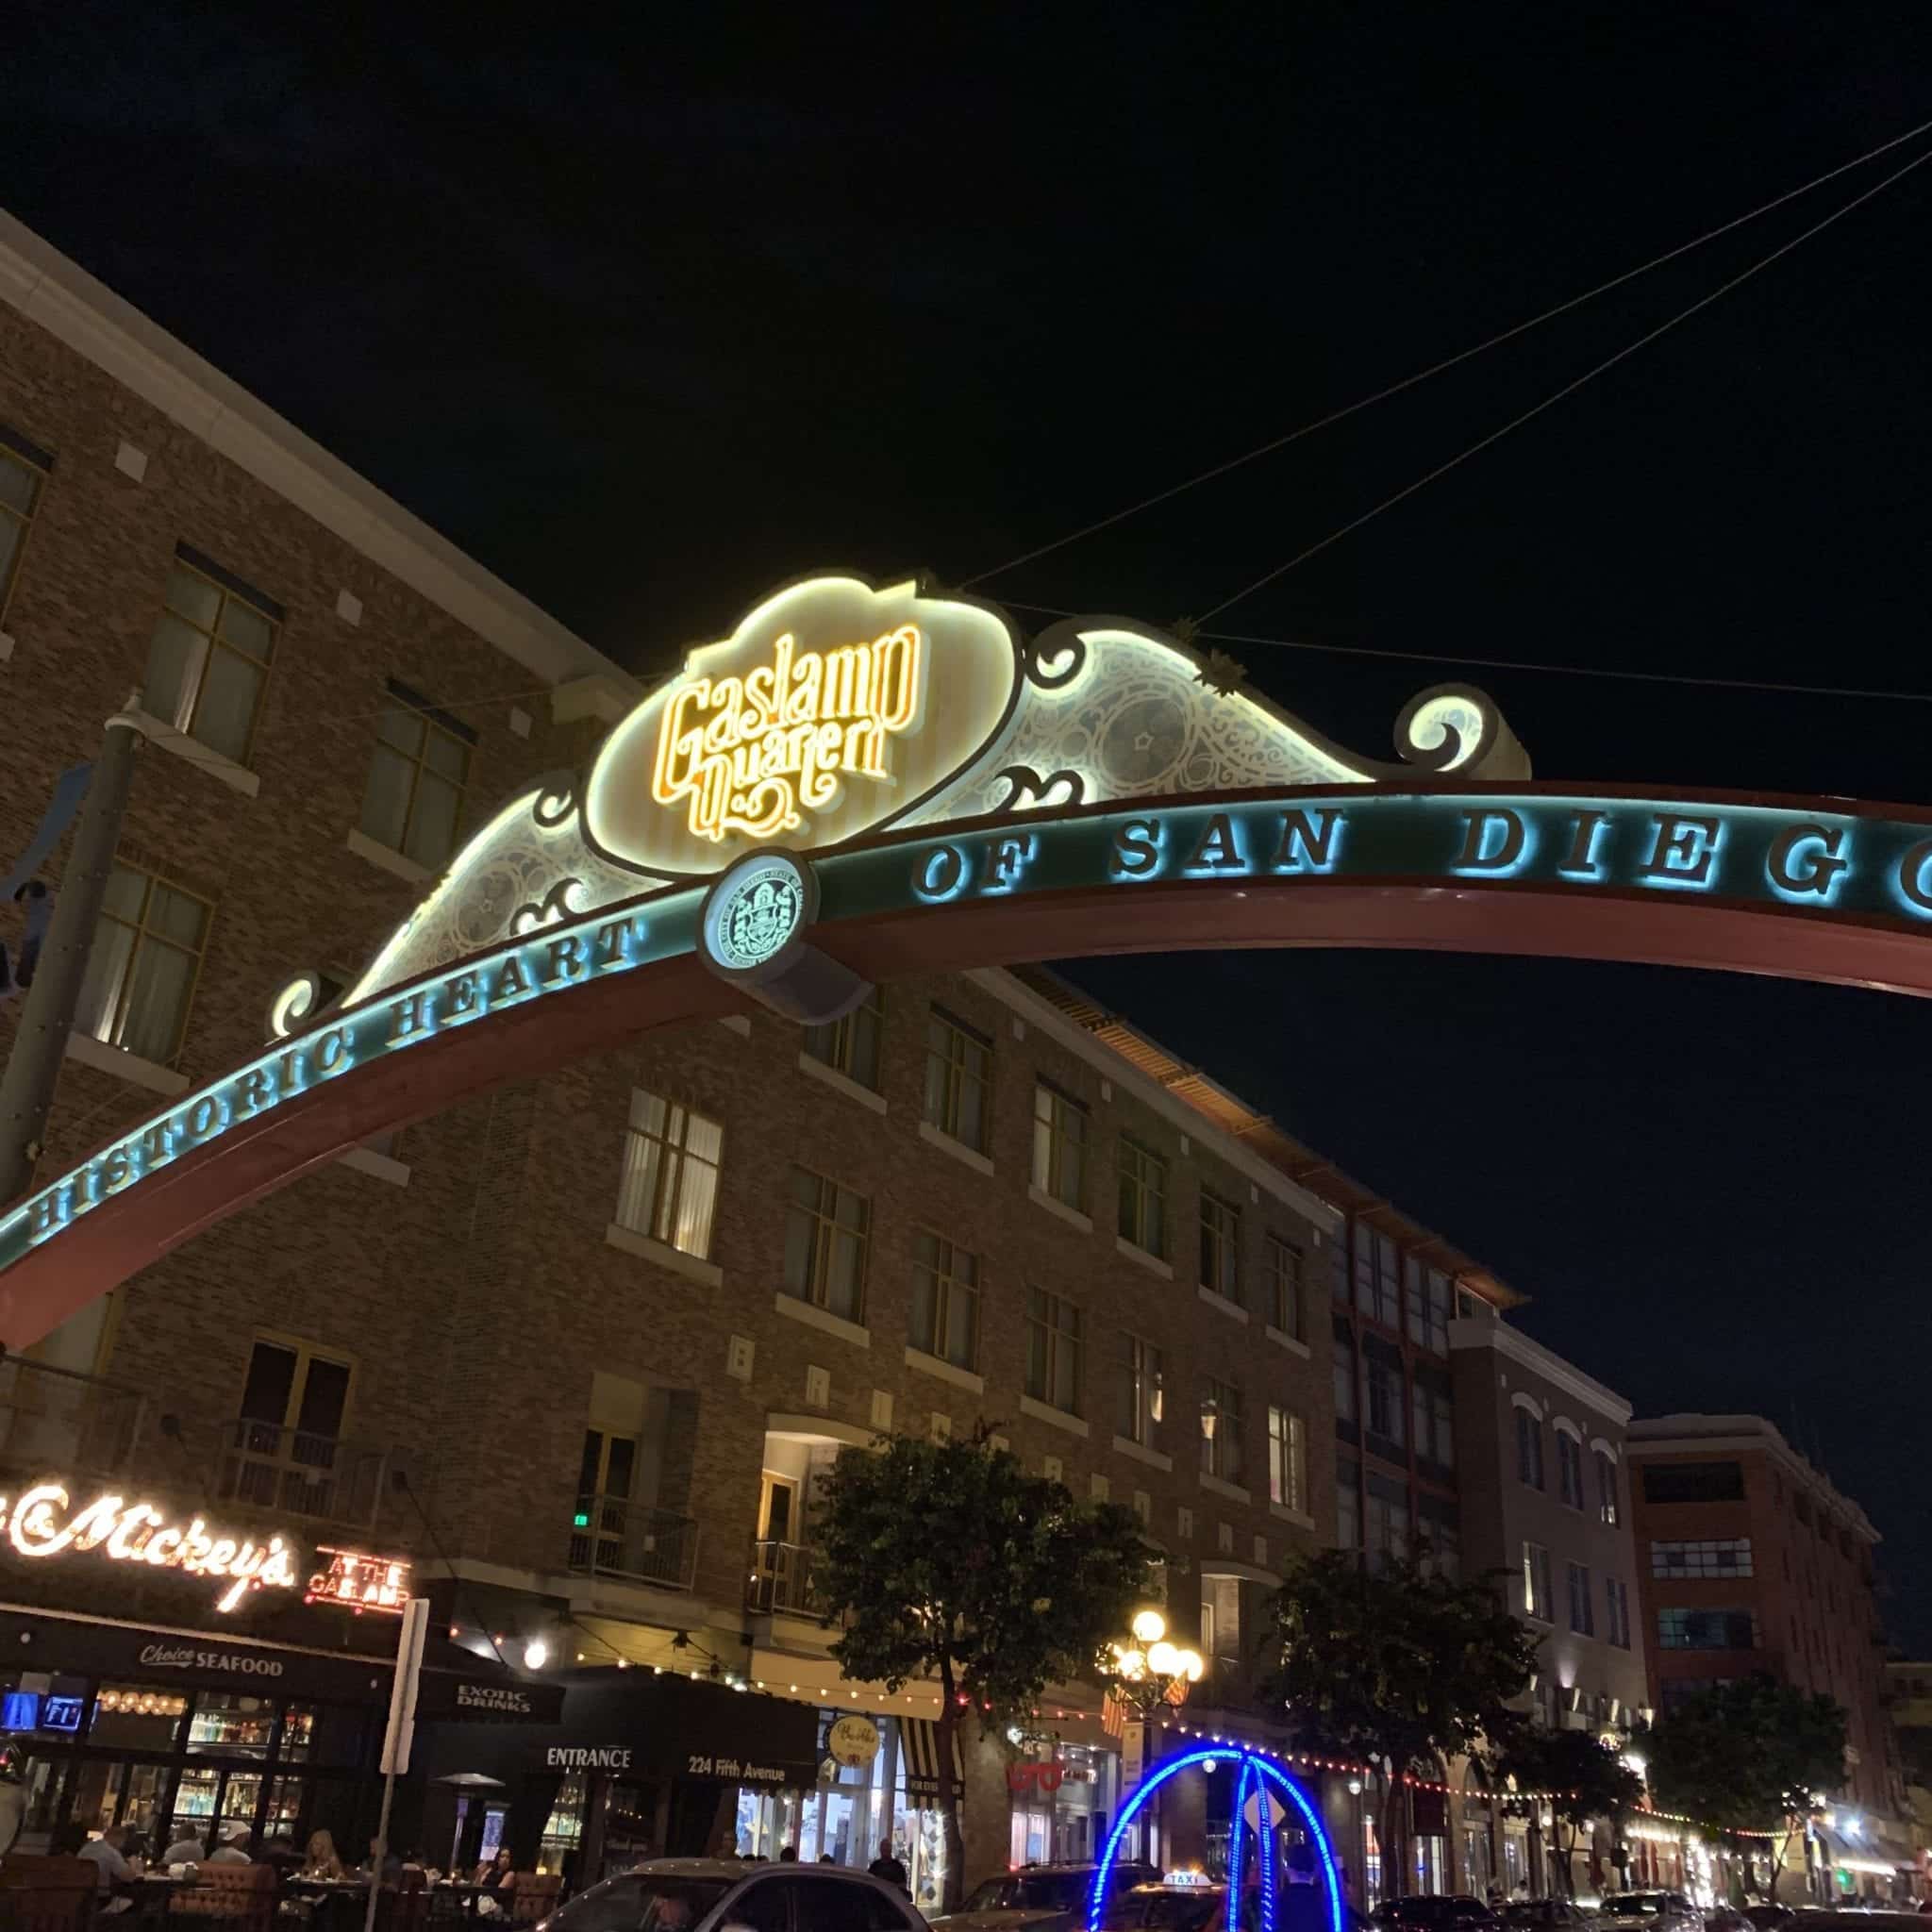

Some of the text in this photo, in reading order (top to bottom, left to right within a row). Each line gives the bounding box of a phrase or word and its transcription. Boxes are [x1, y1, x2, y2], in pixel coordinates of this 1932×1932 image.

[653, 623, 922, 803] Gaslamp
[689, 720, 888, 842] Quarter
[26, 1025, 355, 1245] HISTORIC
[385, 915, 651, 1048] HEART
[911, 829, 1037, 905] OF
[1108, 807, 1347, 881] SAN
[10, 1485, 295, 1613] Mickey's
[328, 1556, 410, 1591] AT THE
[141, 1644, 284, 1677] Choice SEAFOOD
[457, 1695, 532, 1713] DRINKS
[458, 1685, 528, 1702] EXOTIC
[547, 1747, 632, 1769] ENTRANCE
[689, 1756, 786, 1782] 224 Fifth Avenue
[1171, 1874, 1199, 1885] TAXI
